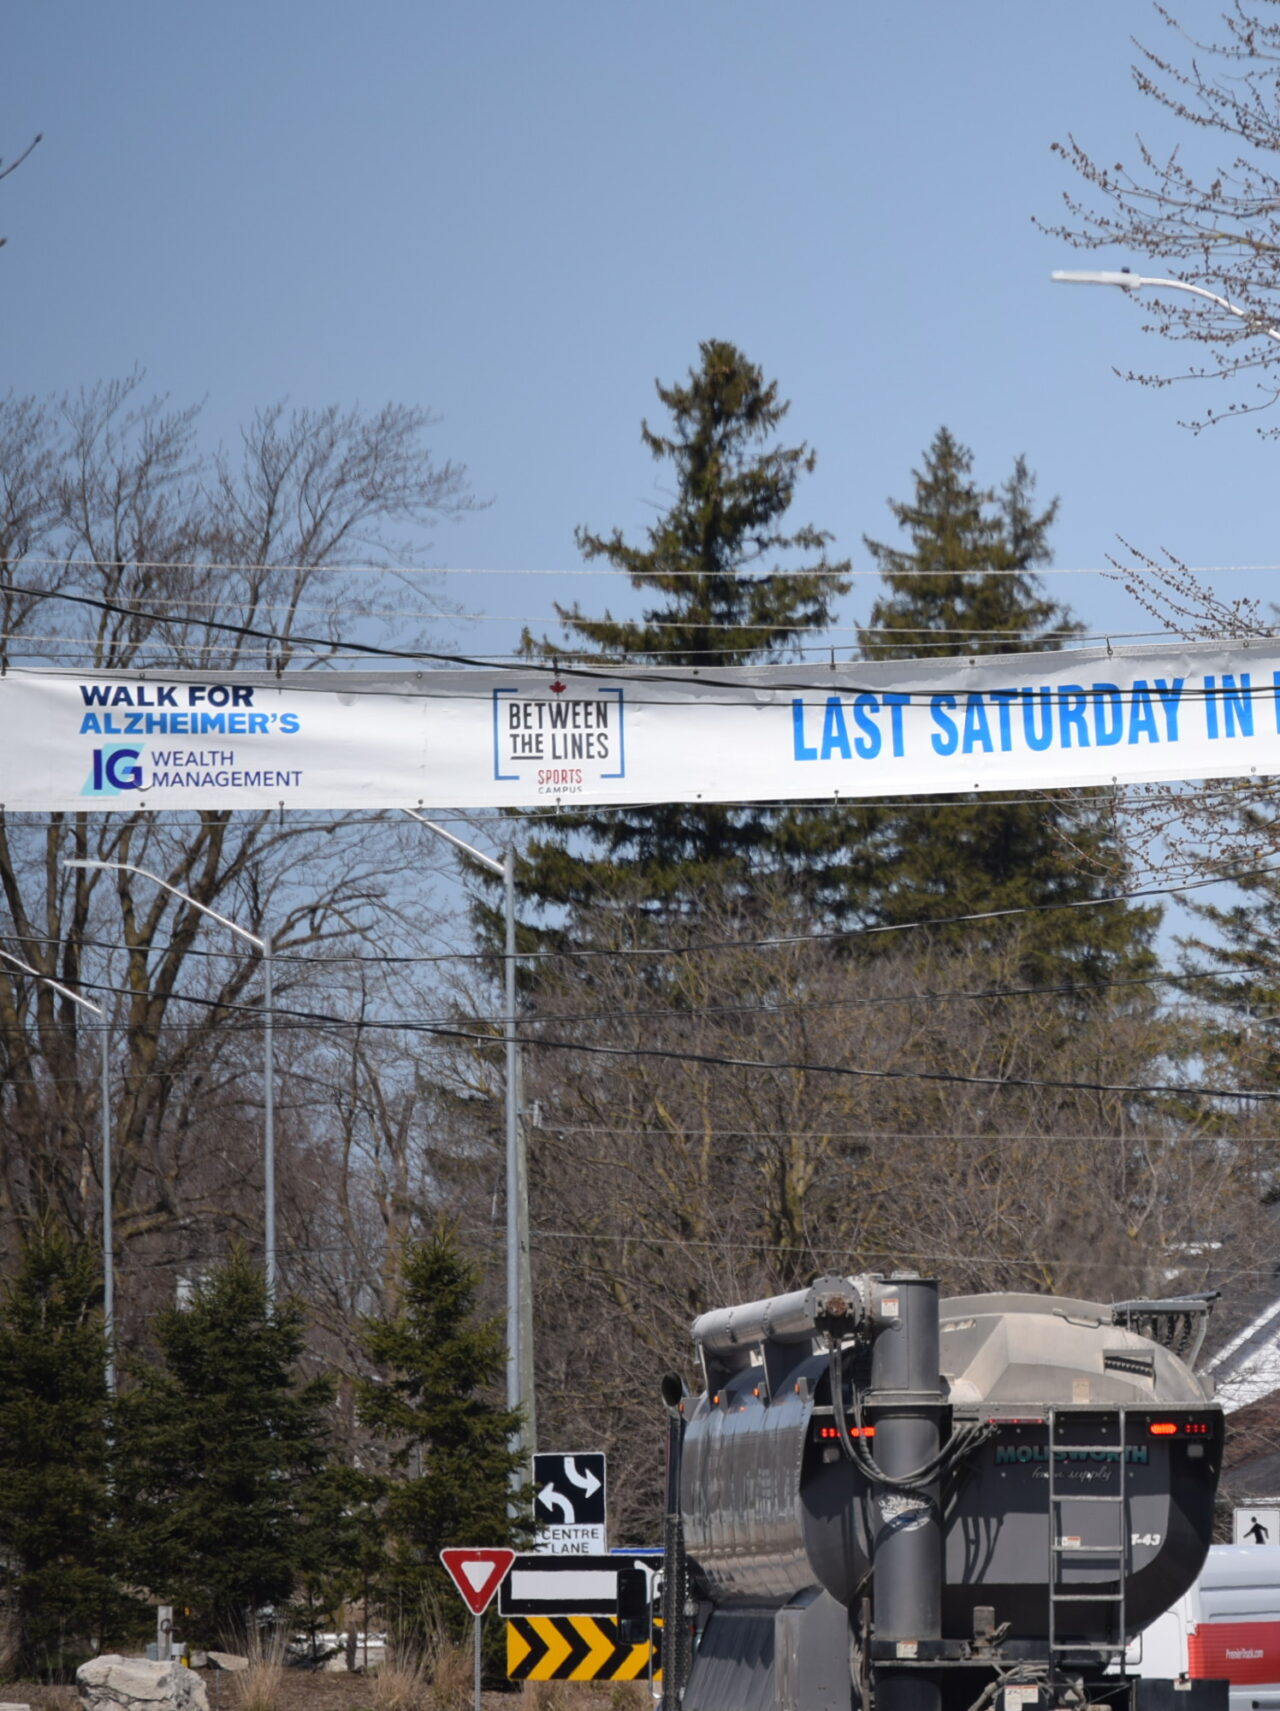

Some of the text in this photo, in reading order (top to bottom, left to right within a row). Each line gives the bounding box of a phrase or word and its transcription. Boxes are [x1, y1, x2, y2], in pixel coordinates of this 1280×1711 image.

[80, 685, 254, 708] WALK FOR
[80, 712, 301, 735] ALZHEIMER'S
[509, 701, 608, 730] BETWEEN
[792, 692, 911, 761] LAST
[931, 678, 1185, 755] SATURDAY
[1204, 673, 1254, 740] IN
[510, 732, 609, 760] THE LINES
[93, 749, 143, 791] IG
[151, 751, 234, 768] WEALTH
[151, 769, 302, 788] MANAGEMENT
[537, 768, 582, 785] SPORTS
[538, 786, 582, 794] CAMPUS
[542, 1528, 599, 1540] CENTRE
[552, 1542, 590, 1554] LANE
